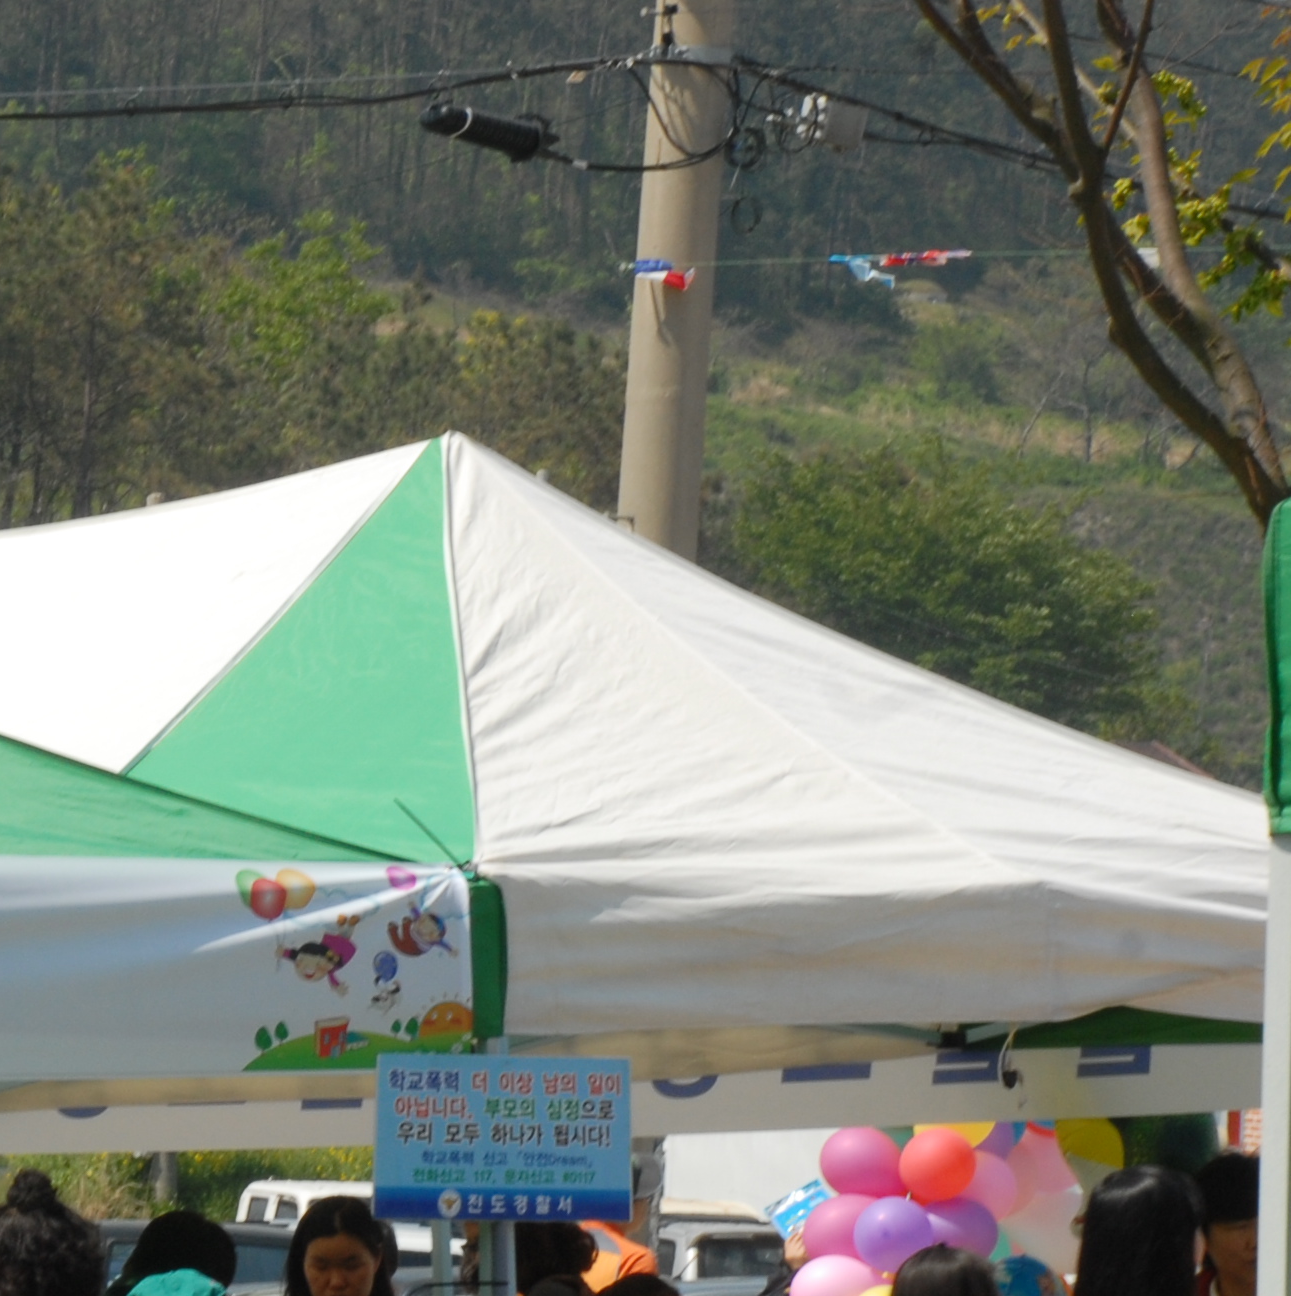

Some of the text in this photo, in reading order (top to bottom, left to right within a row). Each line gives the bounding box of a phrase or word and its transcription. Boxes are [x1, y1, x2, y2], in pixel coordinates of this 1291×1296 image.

[389, 1069, 623, 1097] 학교폭력 더 이상 남의 일이
[483, 1097, 536, 1120] 부모의
[546, 1098, 615, 1122] 심정으로
[397, 1123, 434, 1145] 우리
[444, 1123, 481, 1145] 모두
[491, 1123, 543, 1147] 하나가
[467, 1193, 573, 1216] 진도경찰서
